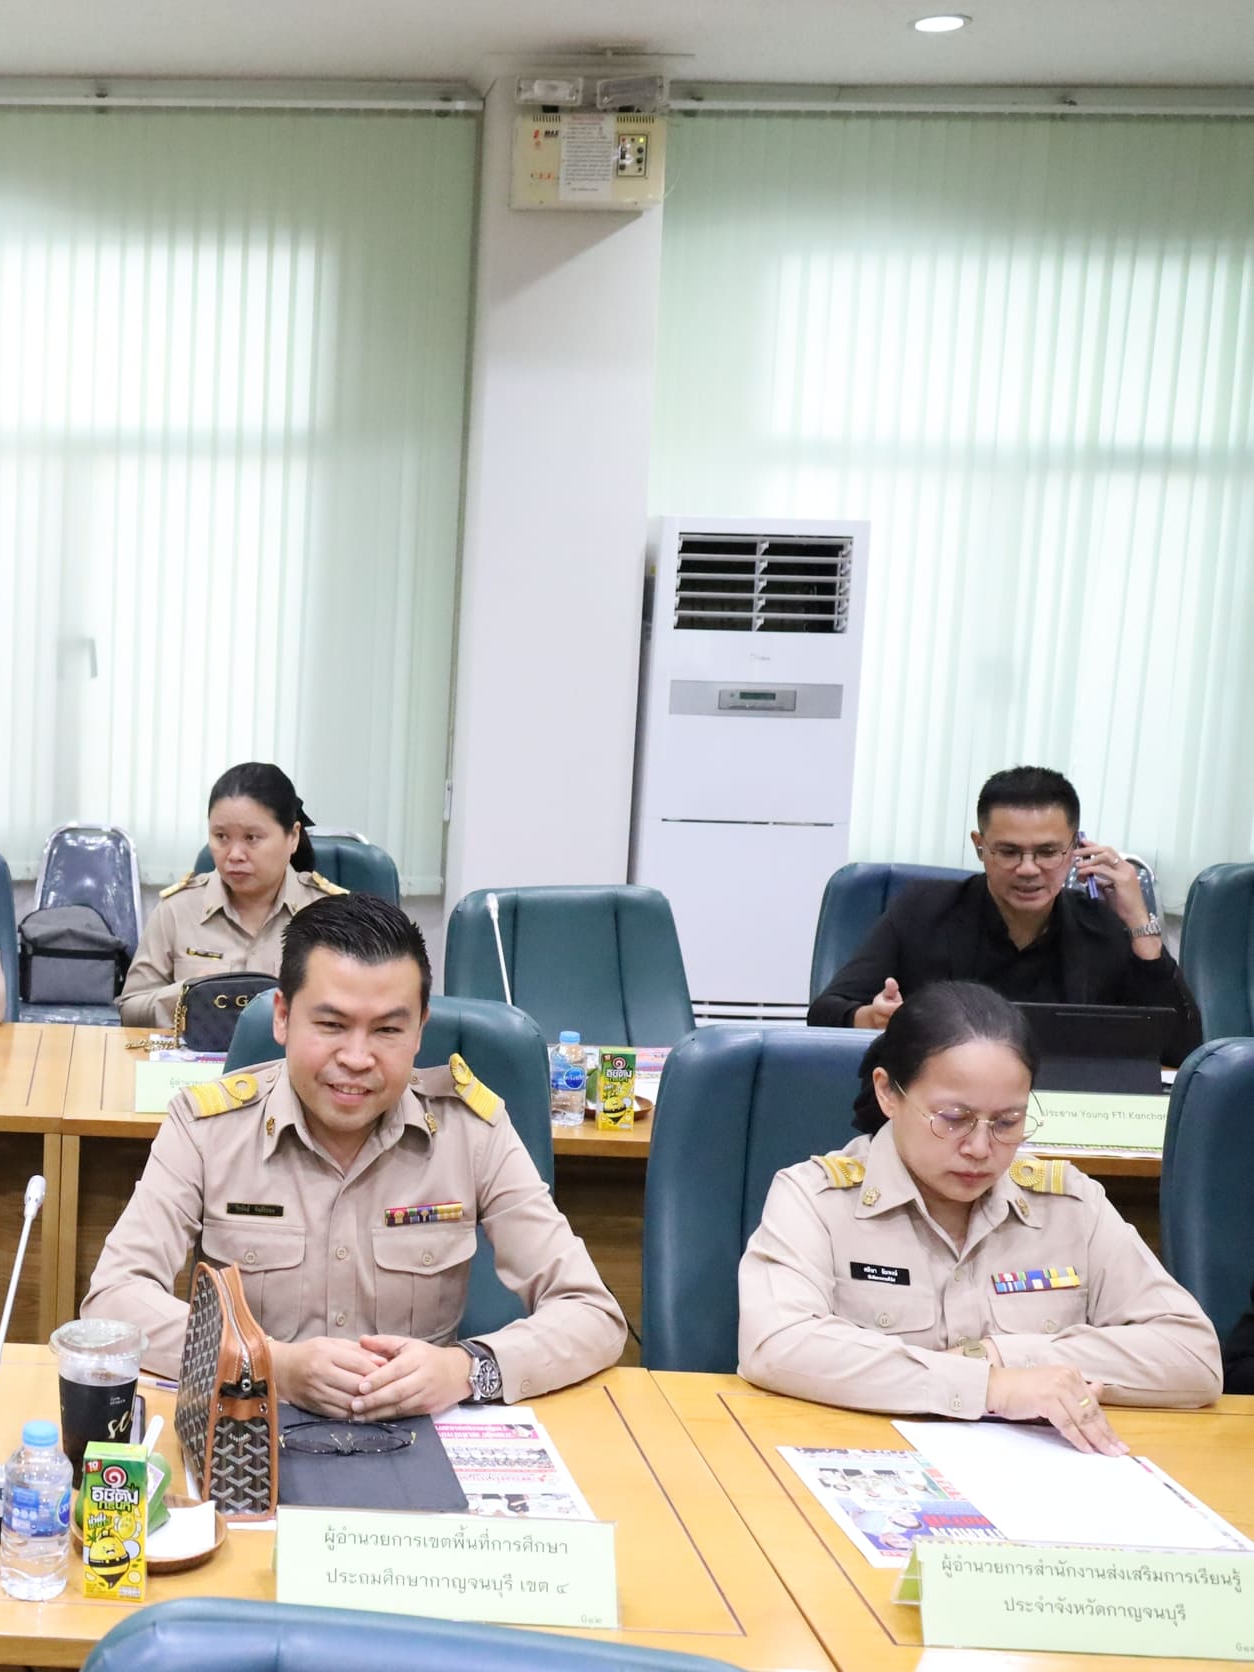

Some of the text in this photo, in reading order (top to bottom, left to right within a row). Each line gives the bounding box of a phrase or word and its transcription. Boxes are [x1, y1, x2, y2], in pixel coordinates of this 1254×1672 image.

[1081, 1110, 1109, 1120] Young
[1112, 1111, 1125, 1119] FTI
[324, 1524, 569, 1555] ผู้อำนวยการเขตพื้นที่การศึกษา
[326, 1567, 570, 1598] ประถมศึกษากาญจนบุรี เขต ๔
[941, 1555, 1243, 1593] ผู้อำนวยการสำนักงานส่งเสริมการเรียนรู้
[1003, 1595, 1187, 1628] ประจำจังหวัดกาญจนบุรี
